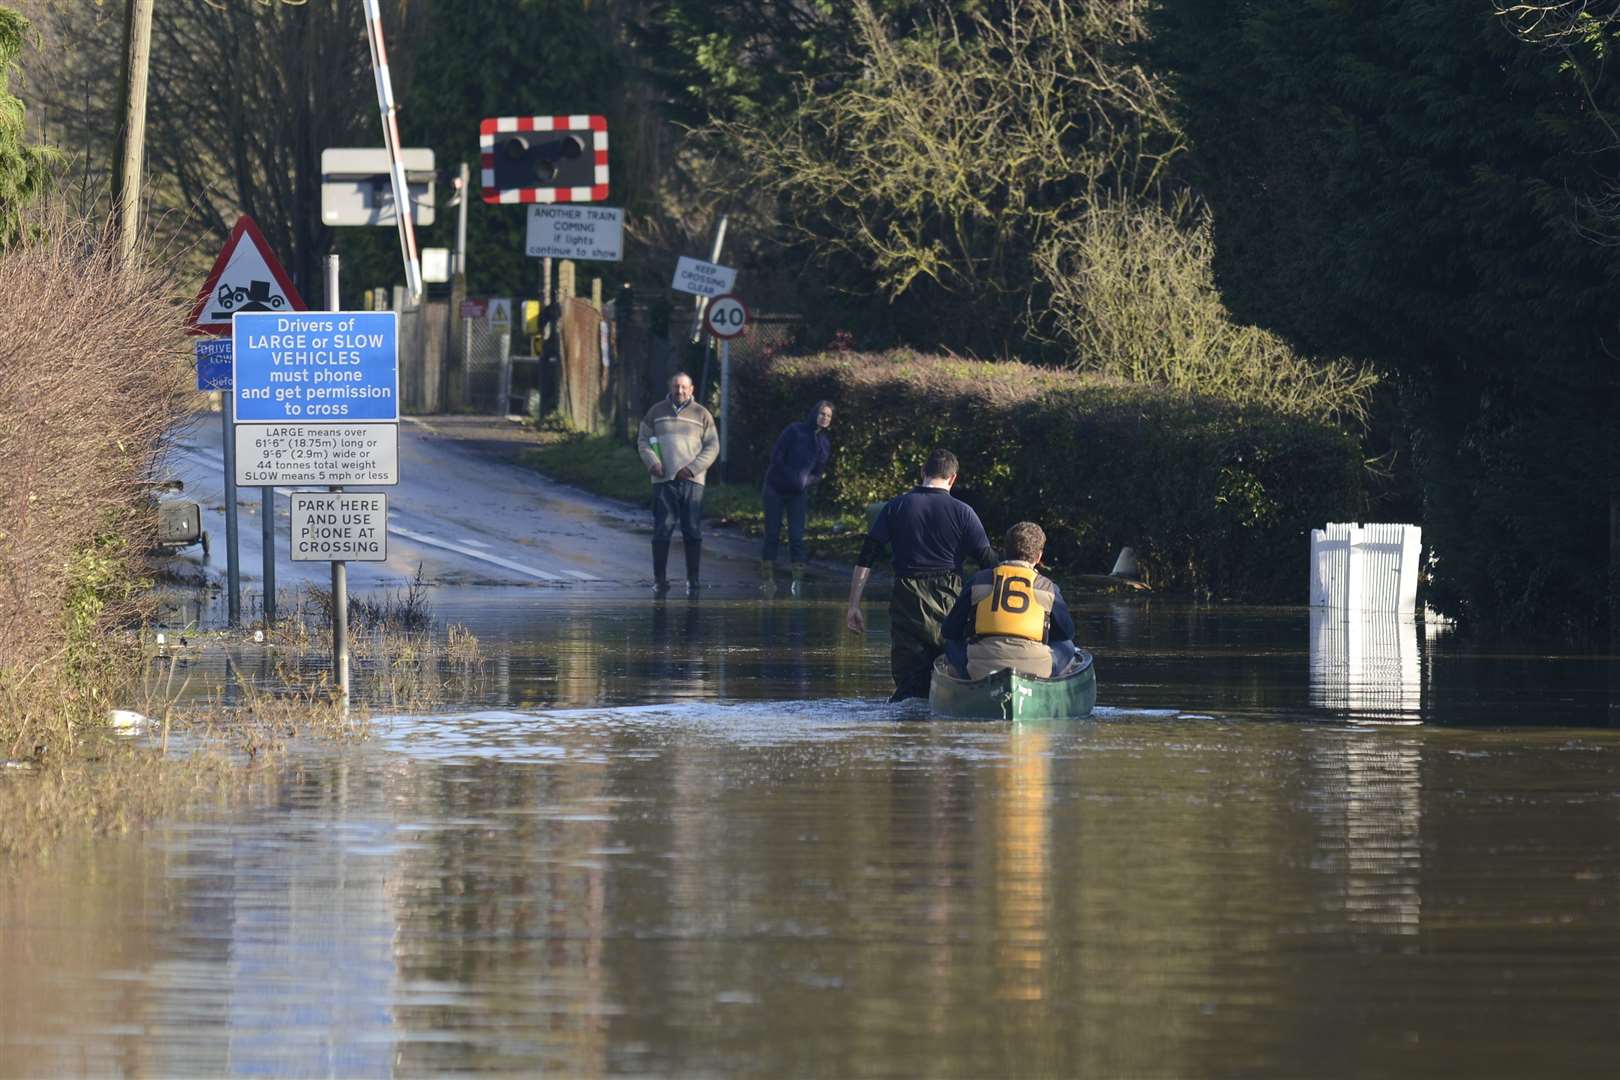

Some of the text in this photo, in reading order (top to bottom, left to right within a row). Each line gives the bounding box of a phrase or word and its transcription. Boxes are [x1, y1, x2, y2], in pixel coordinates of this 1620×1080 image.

[534, 207, 616, 221] ANOTHER TRAIN
[553, 221, 596, 233] COMING
[566, 234, 594, 246] lights
[529, 246, 617, 257] continue to show
[695, 264, 717, 275] KEEP
[681, 270, 726, 289] CROSSING
[687, 281, 714, 294] CLEAR
[712, 307, 744, 327] 40
[277, 318, 355, 332] Drivers of
[249, 334, 384, 349] LARGE or SLOW
[271, 351, 361, 366] VEHICLES
[270, 368, 363, 384] must phone
[241, 385, 391, 401] and get permission
[284, 402, 349, 415] to cross
[266, 428, 367, 437] LARGE means over
[288, 438, 337, 449] (18.75m)
[341, 438, 364, 450] long
[366, 439, 377, 447] or
[291, 449, 328, 460] (2.9m)
[332, 449, 357, 459] wide
[359, 450, 371, 459] or
[257, 460, 376, 472] 44 tonnes total weight
[245, 470, 389, 482] SLOW means 5 mph or less
[298, 499, 379, 512] PARK HERE
[306, 513, 371, 525] AND USE
[301, 527, 375, 539] PHONE AT
[299, 541, 379, 553] CROSSING
[991, 574, 1032, 614] 16
